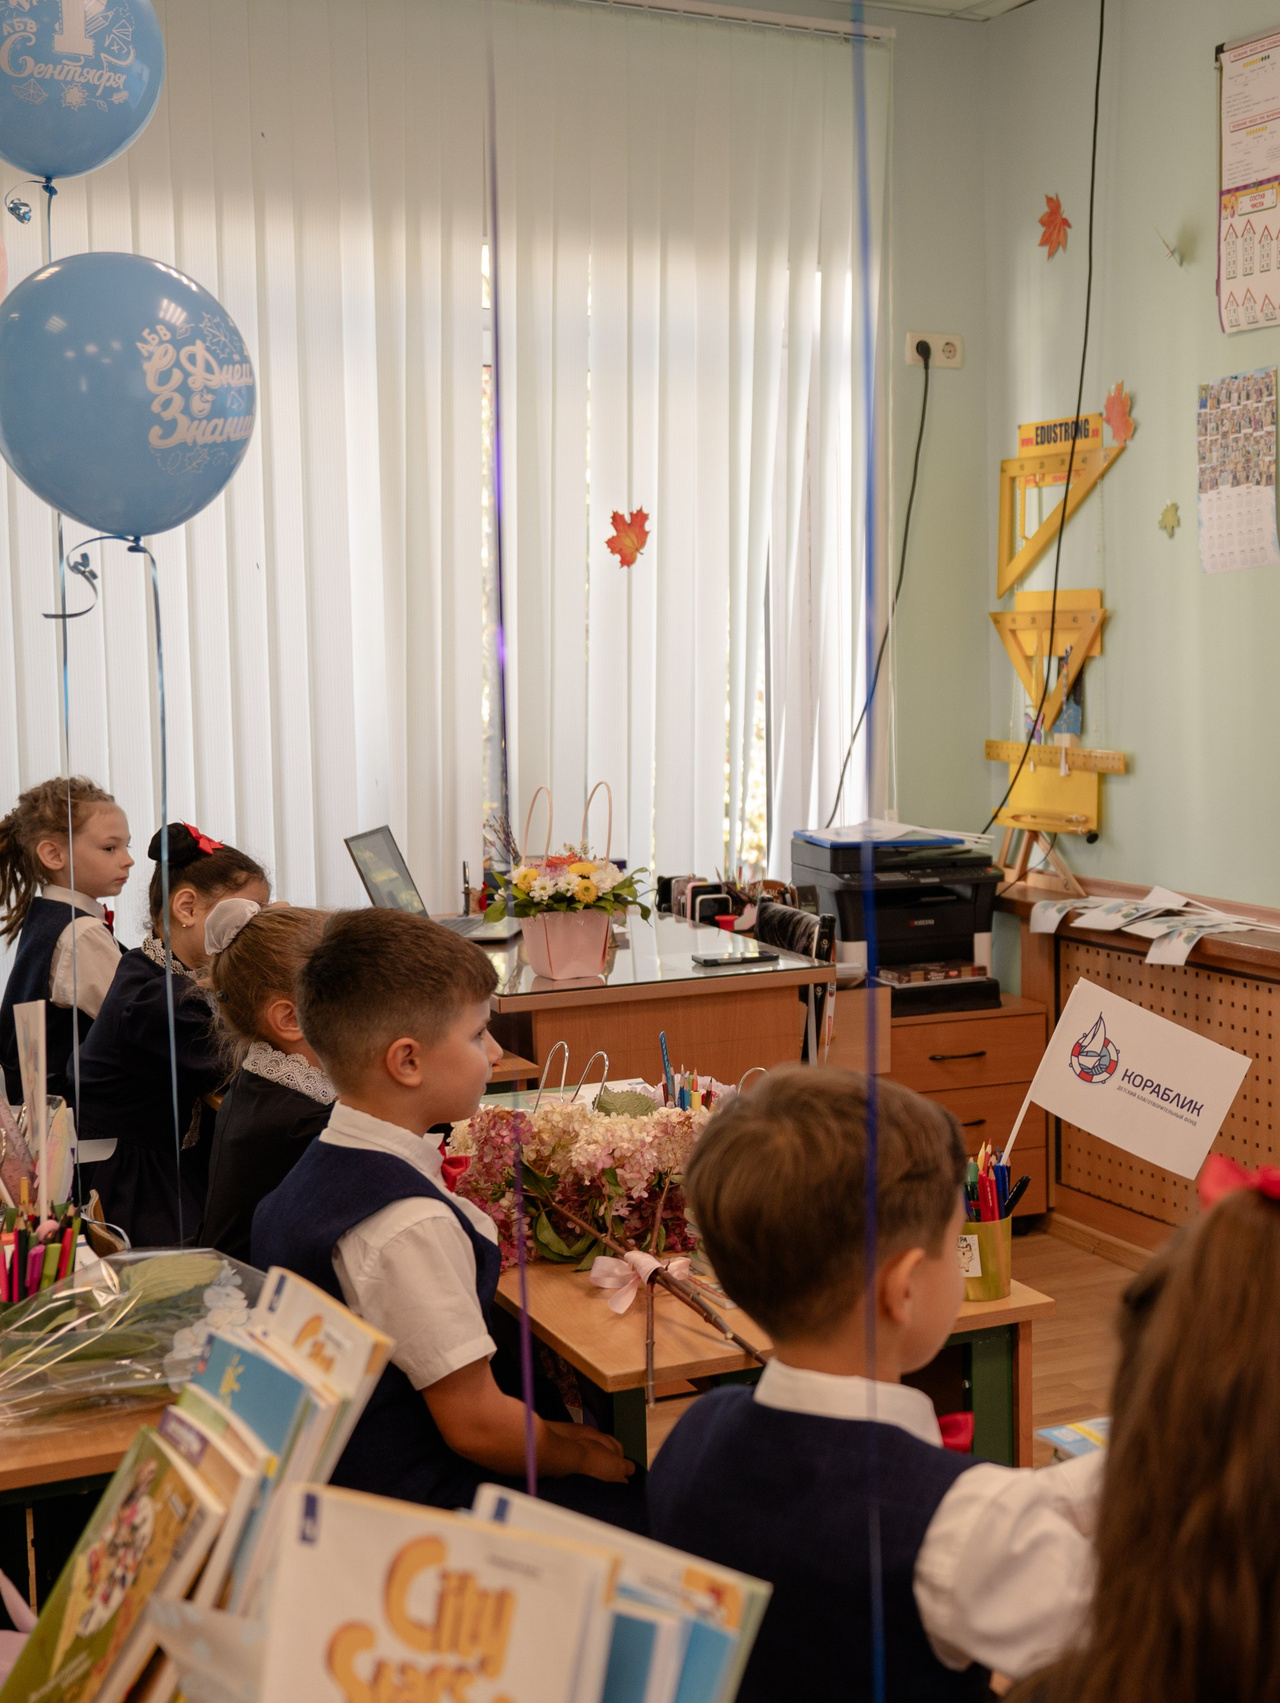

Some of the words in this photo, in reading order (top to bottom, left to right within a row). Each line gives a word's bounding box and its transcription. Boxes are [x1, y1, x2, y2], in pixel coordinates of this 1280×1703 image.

[0, 31, 135, 96] Сентября
[1249, 193, 1266, 202] СОСТАВ
[1116, 1085, 1137, 1097] ДЕТСКИЙ
[1137, 1094, 1184, 1120] БЛАГОТВОРИТЕЛЬНЫЙ
[1183, 1117, 1198, 1127] ФОНД
[1121, 1068, 1204, 1117] КОРАБЛИК
[382, 1533, 518, 1681] City
